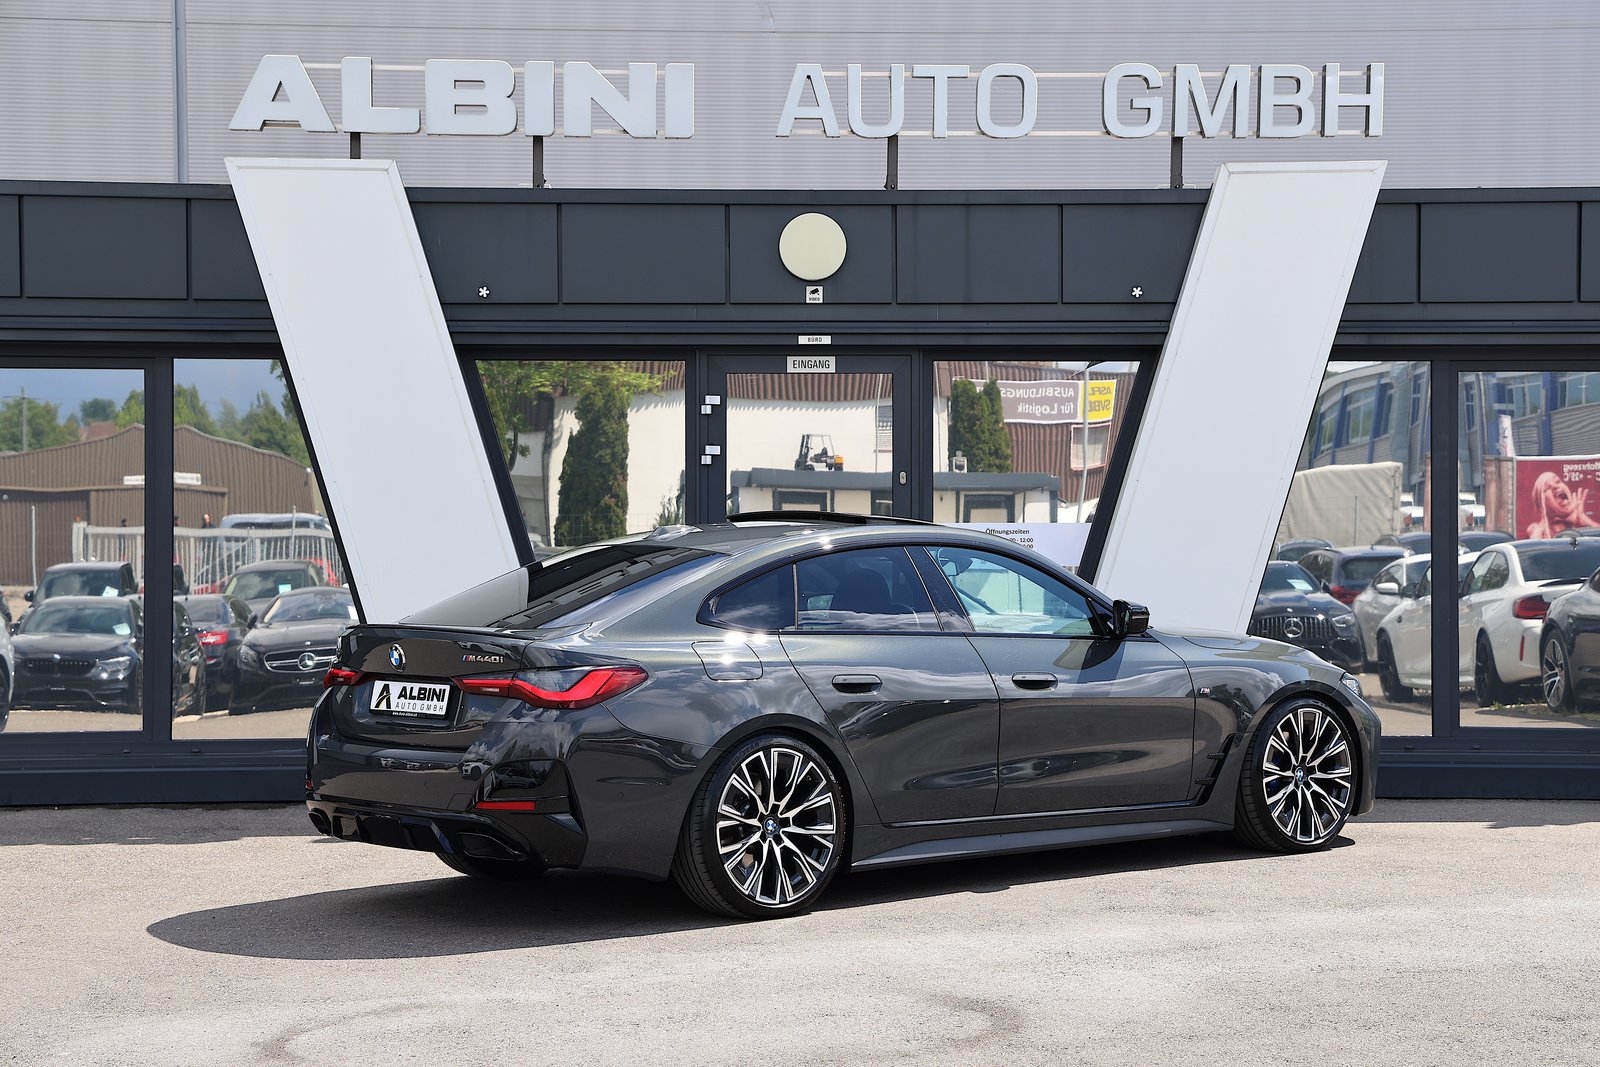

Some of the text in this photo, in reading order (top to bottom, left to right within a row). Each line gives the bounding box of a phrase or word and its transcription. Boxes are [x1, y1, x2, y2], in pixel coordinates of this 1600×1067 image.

[229, 54, 1385, 139] ALBINI AUTO GMBH
[792, 359, 830, 369] EINGANG
[397, 686, 446, 702] ALBINI
[395, 702, 444, 712] AUTO GMBH
